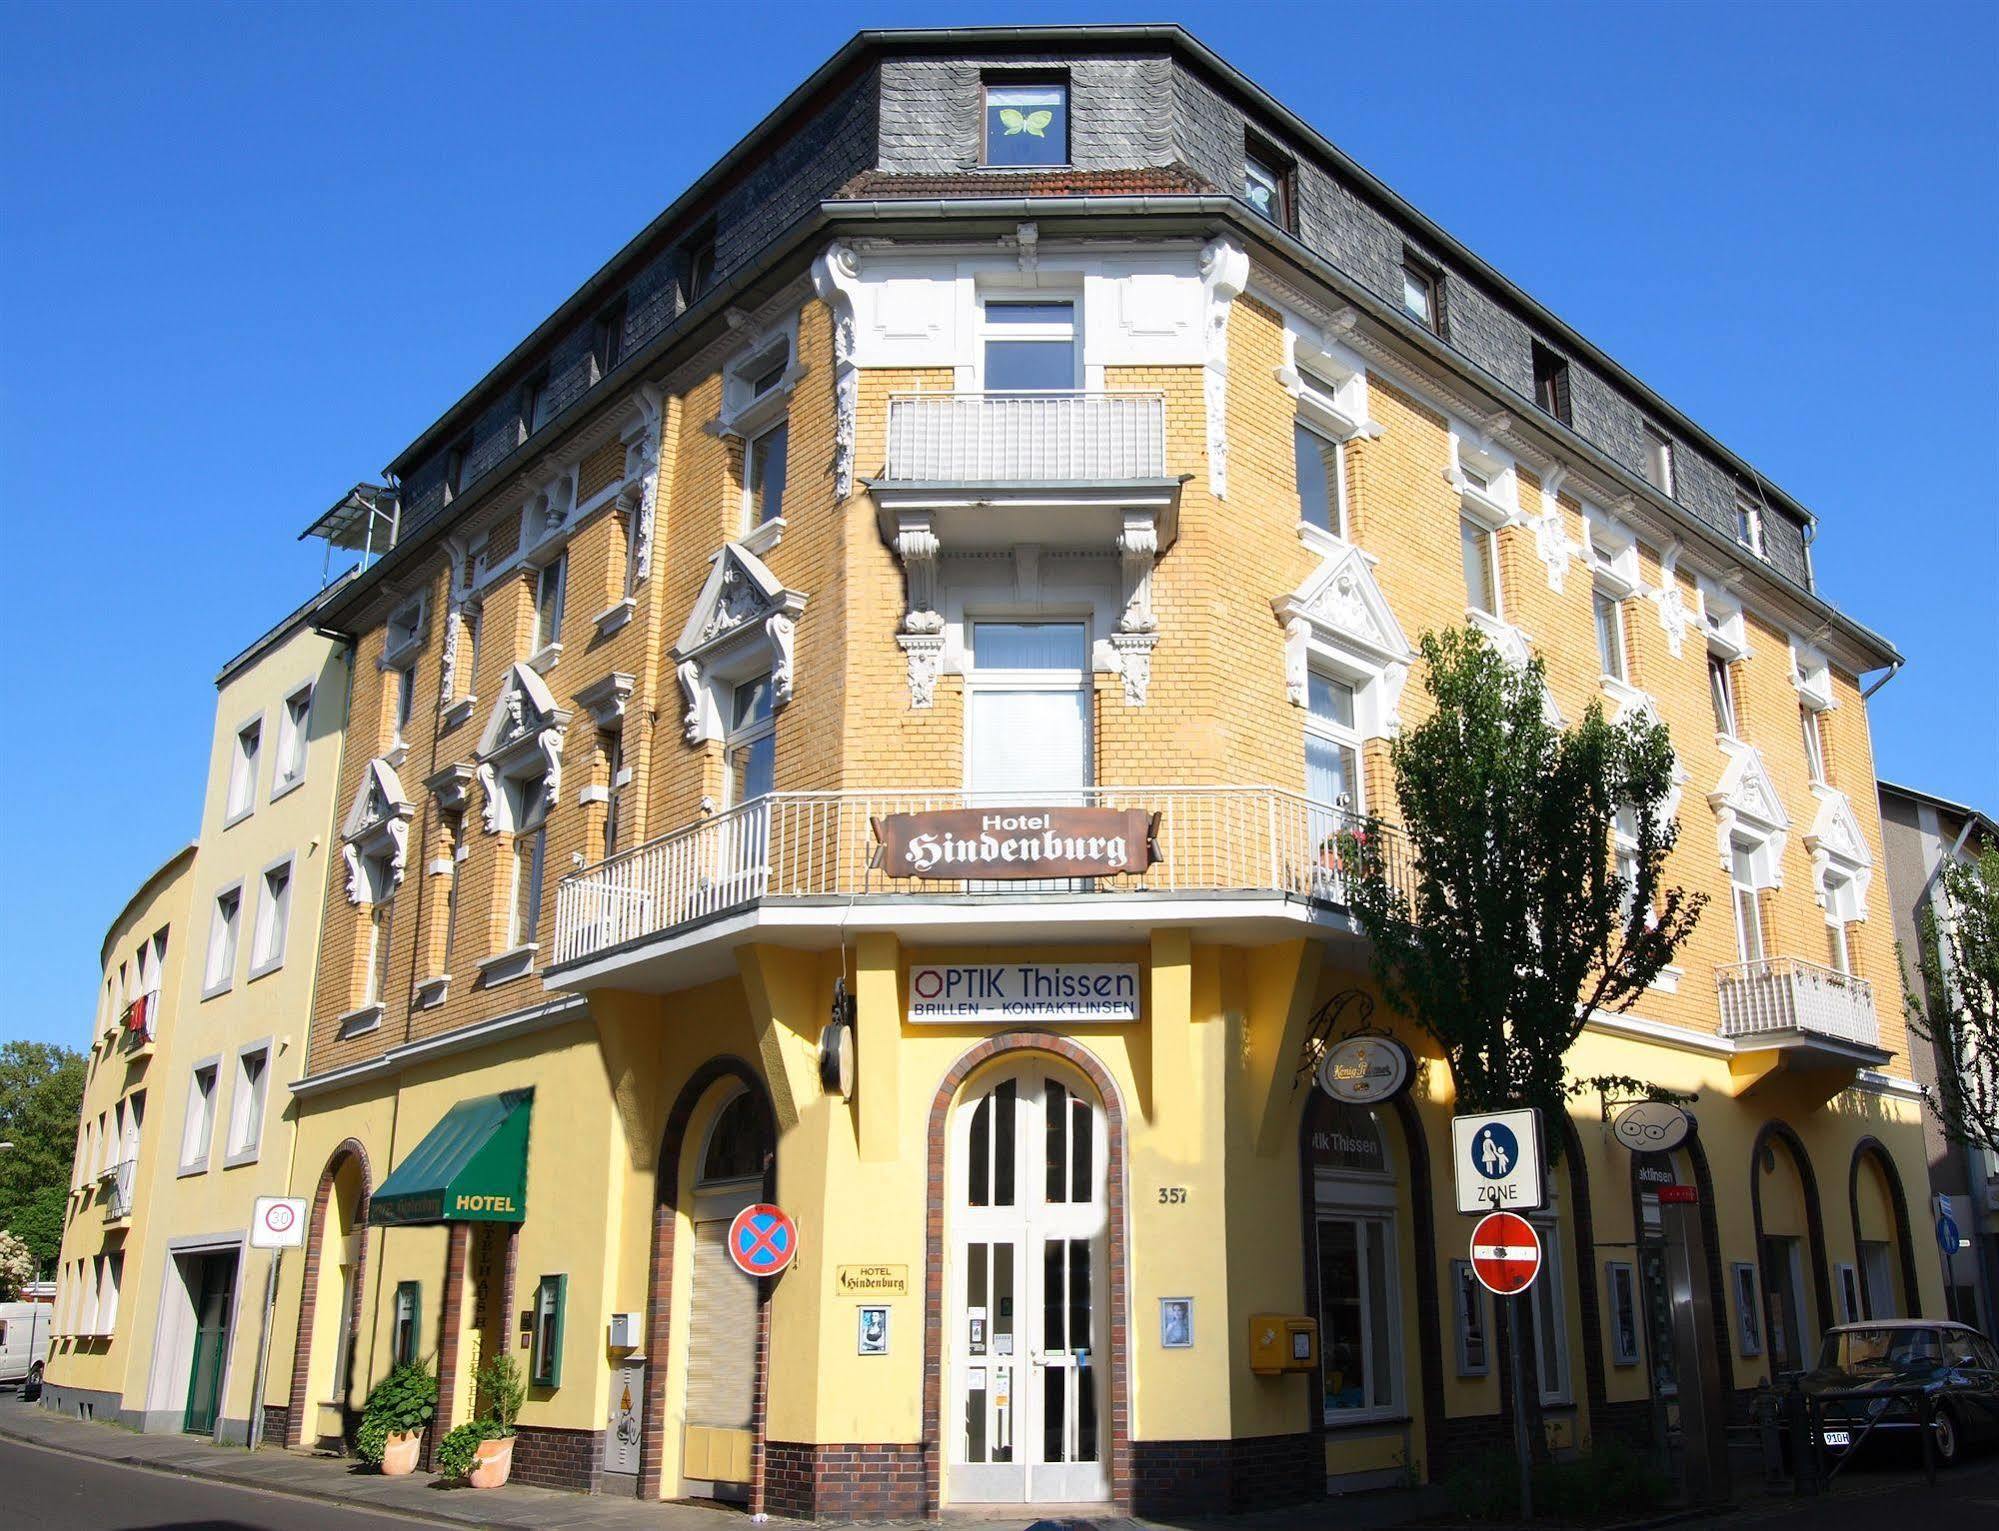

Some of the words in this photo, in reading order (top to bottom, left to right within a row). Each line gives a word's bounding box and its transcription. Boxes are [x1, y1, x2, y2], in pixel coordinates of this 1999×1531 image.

[982, 814, 1050, 831] Hotel
[905, 830, 1128, 872] Hindenburg
[915, 968, 1005, 999] OPTIK
[1018, 967, 1135, 998] Thissen
[914, 1002, 979, 1016] BRILLEN
[1002, 1001, 1135, 1015] KONTAKTLINSEN
[1330, 1133, 1377, 1152] Thissen
[1158, 1187, 1187, 1204] 357
[1478, 1185, 1518, 1202] ZONE
[456, 1195, 516, 1212] HOTEL
[271, 1211, 288, 1225] 30
[860, 1267, 892, 1276] HOTEL
[847, 1277, 905, 1291] Hindenburg
